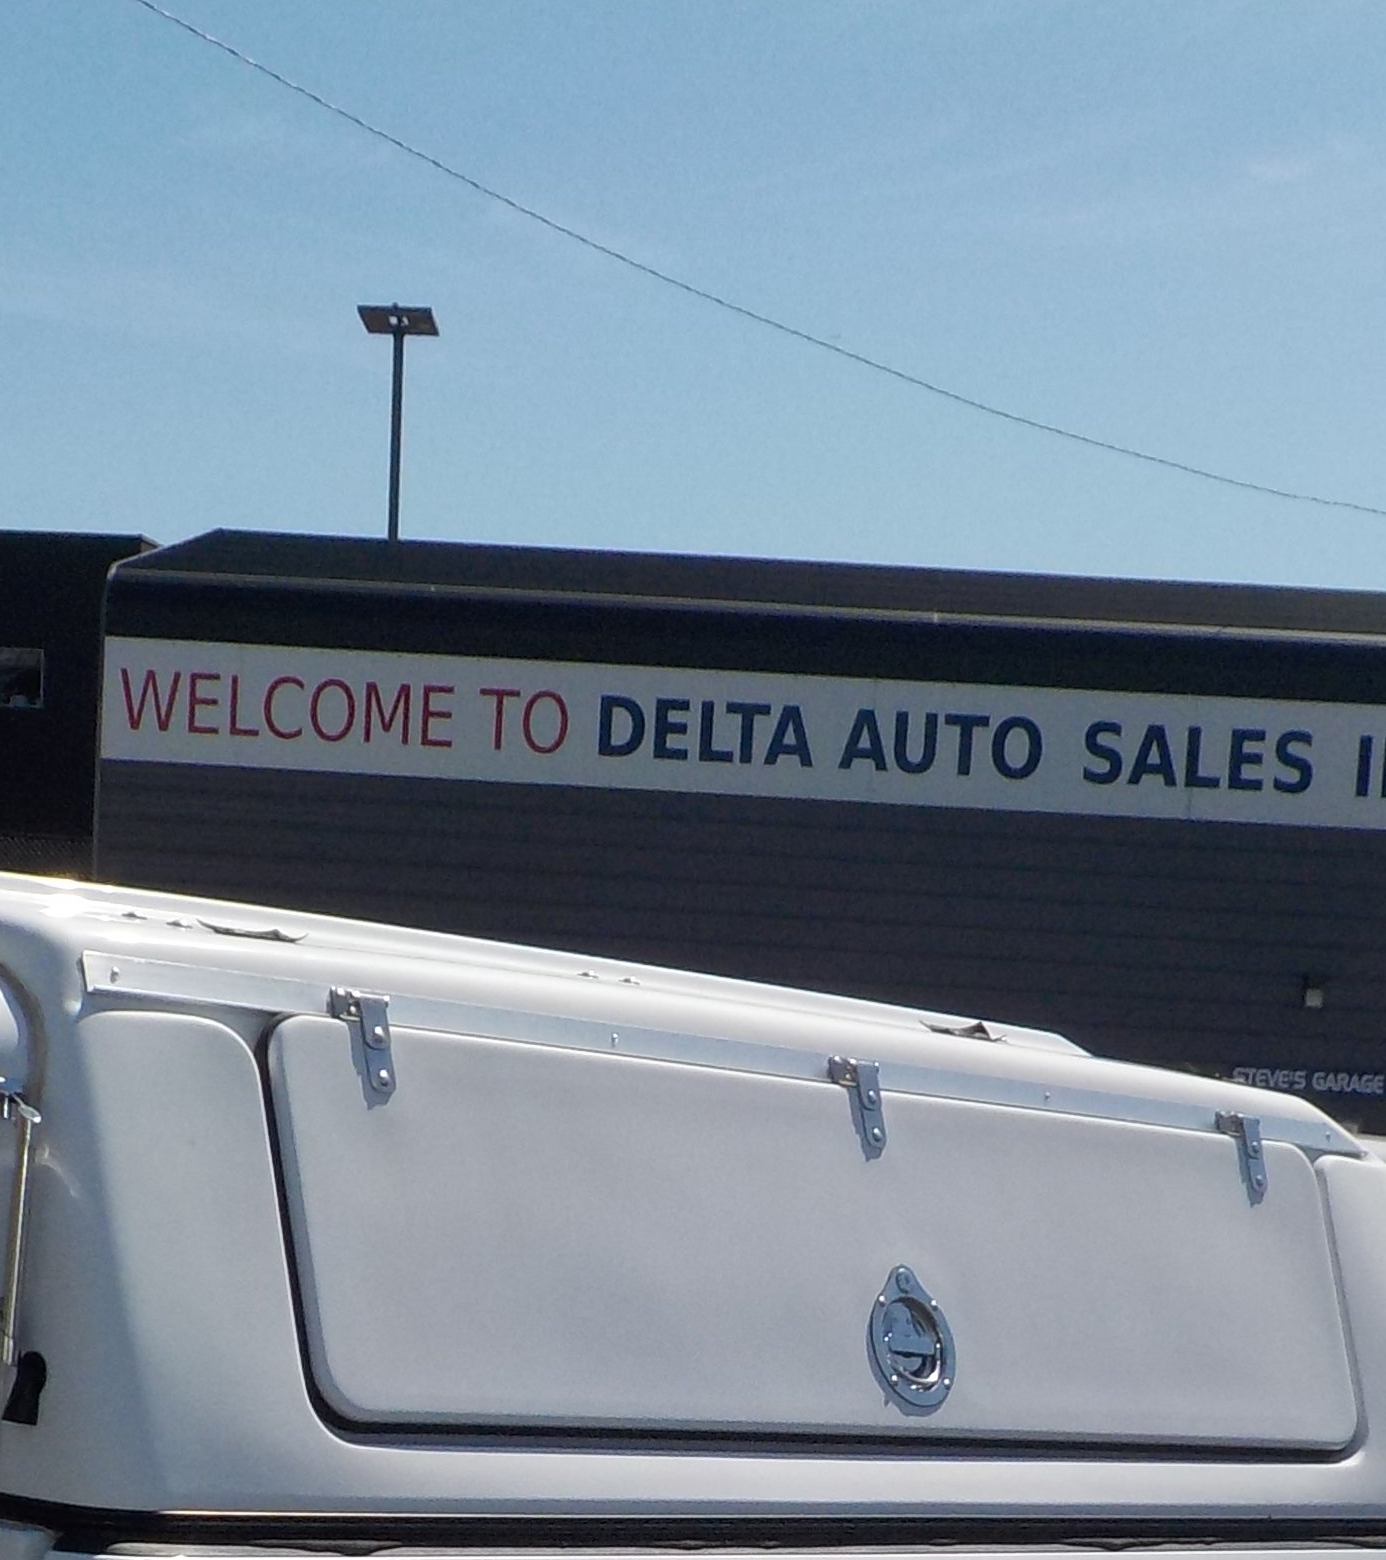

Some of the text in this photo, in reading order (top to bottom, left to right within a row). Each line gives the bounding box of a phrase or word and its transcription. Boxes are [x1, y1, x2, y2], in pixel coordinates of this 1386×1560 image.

[119, 667, 456, 748] WELCOME
[479, 685, 569, 755] TO
[597, 693, 813, 768] DELTA
[837, 707, 1044, 780] AUTO
[1081, 719, 1314, 794] SALES
[1232, 1066, 1385, 1094] STEVE'S GARAGE
